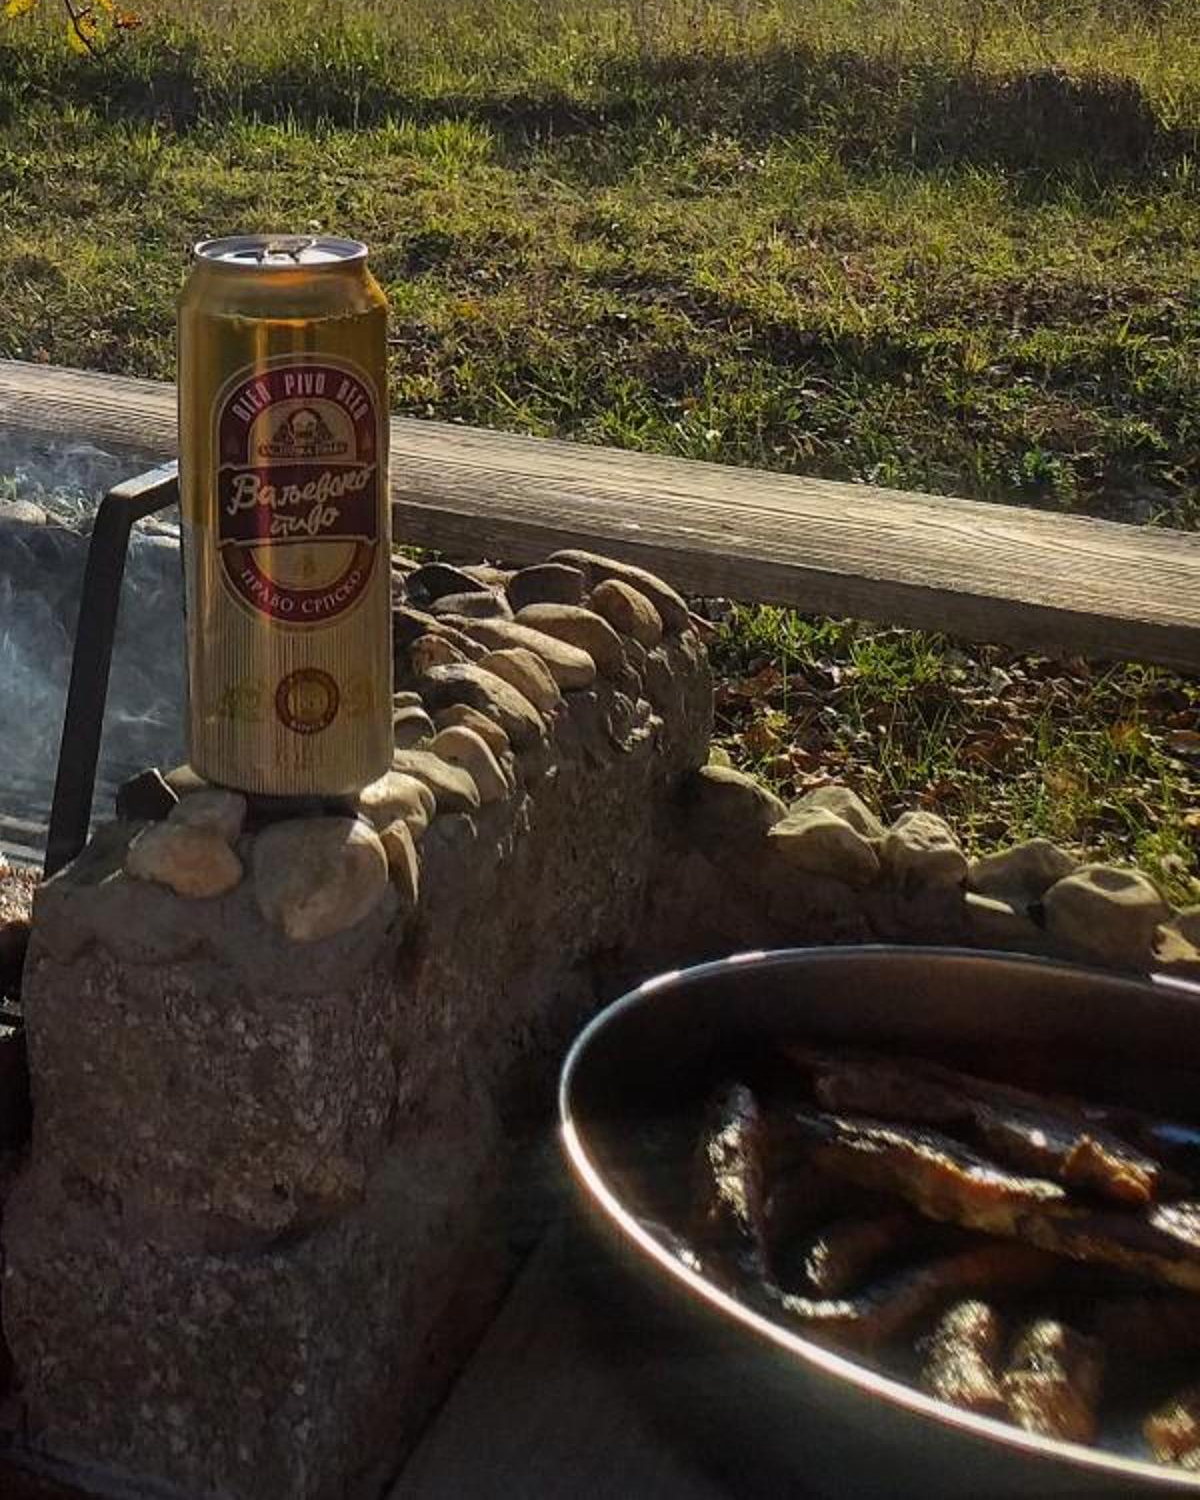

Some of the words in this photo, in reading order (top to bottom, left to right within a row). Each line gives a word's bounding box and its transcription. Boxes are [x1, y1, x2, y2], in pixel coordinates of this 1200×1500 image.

[231, 379, 272, 422] BIER
[284, 372, 327, 396] PIVO
[336, 378, 370, 422] BEER
